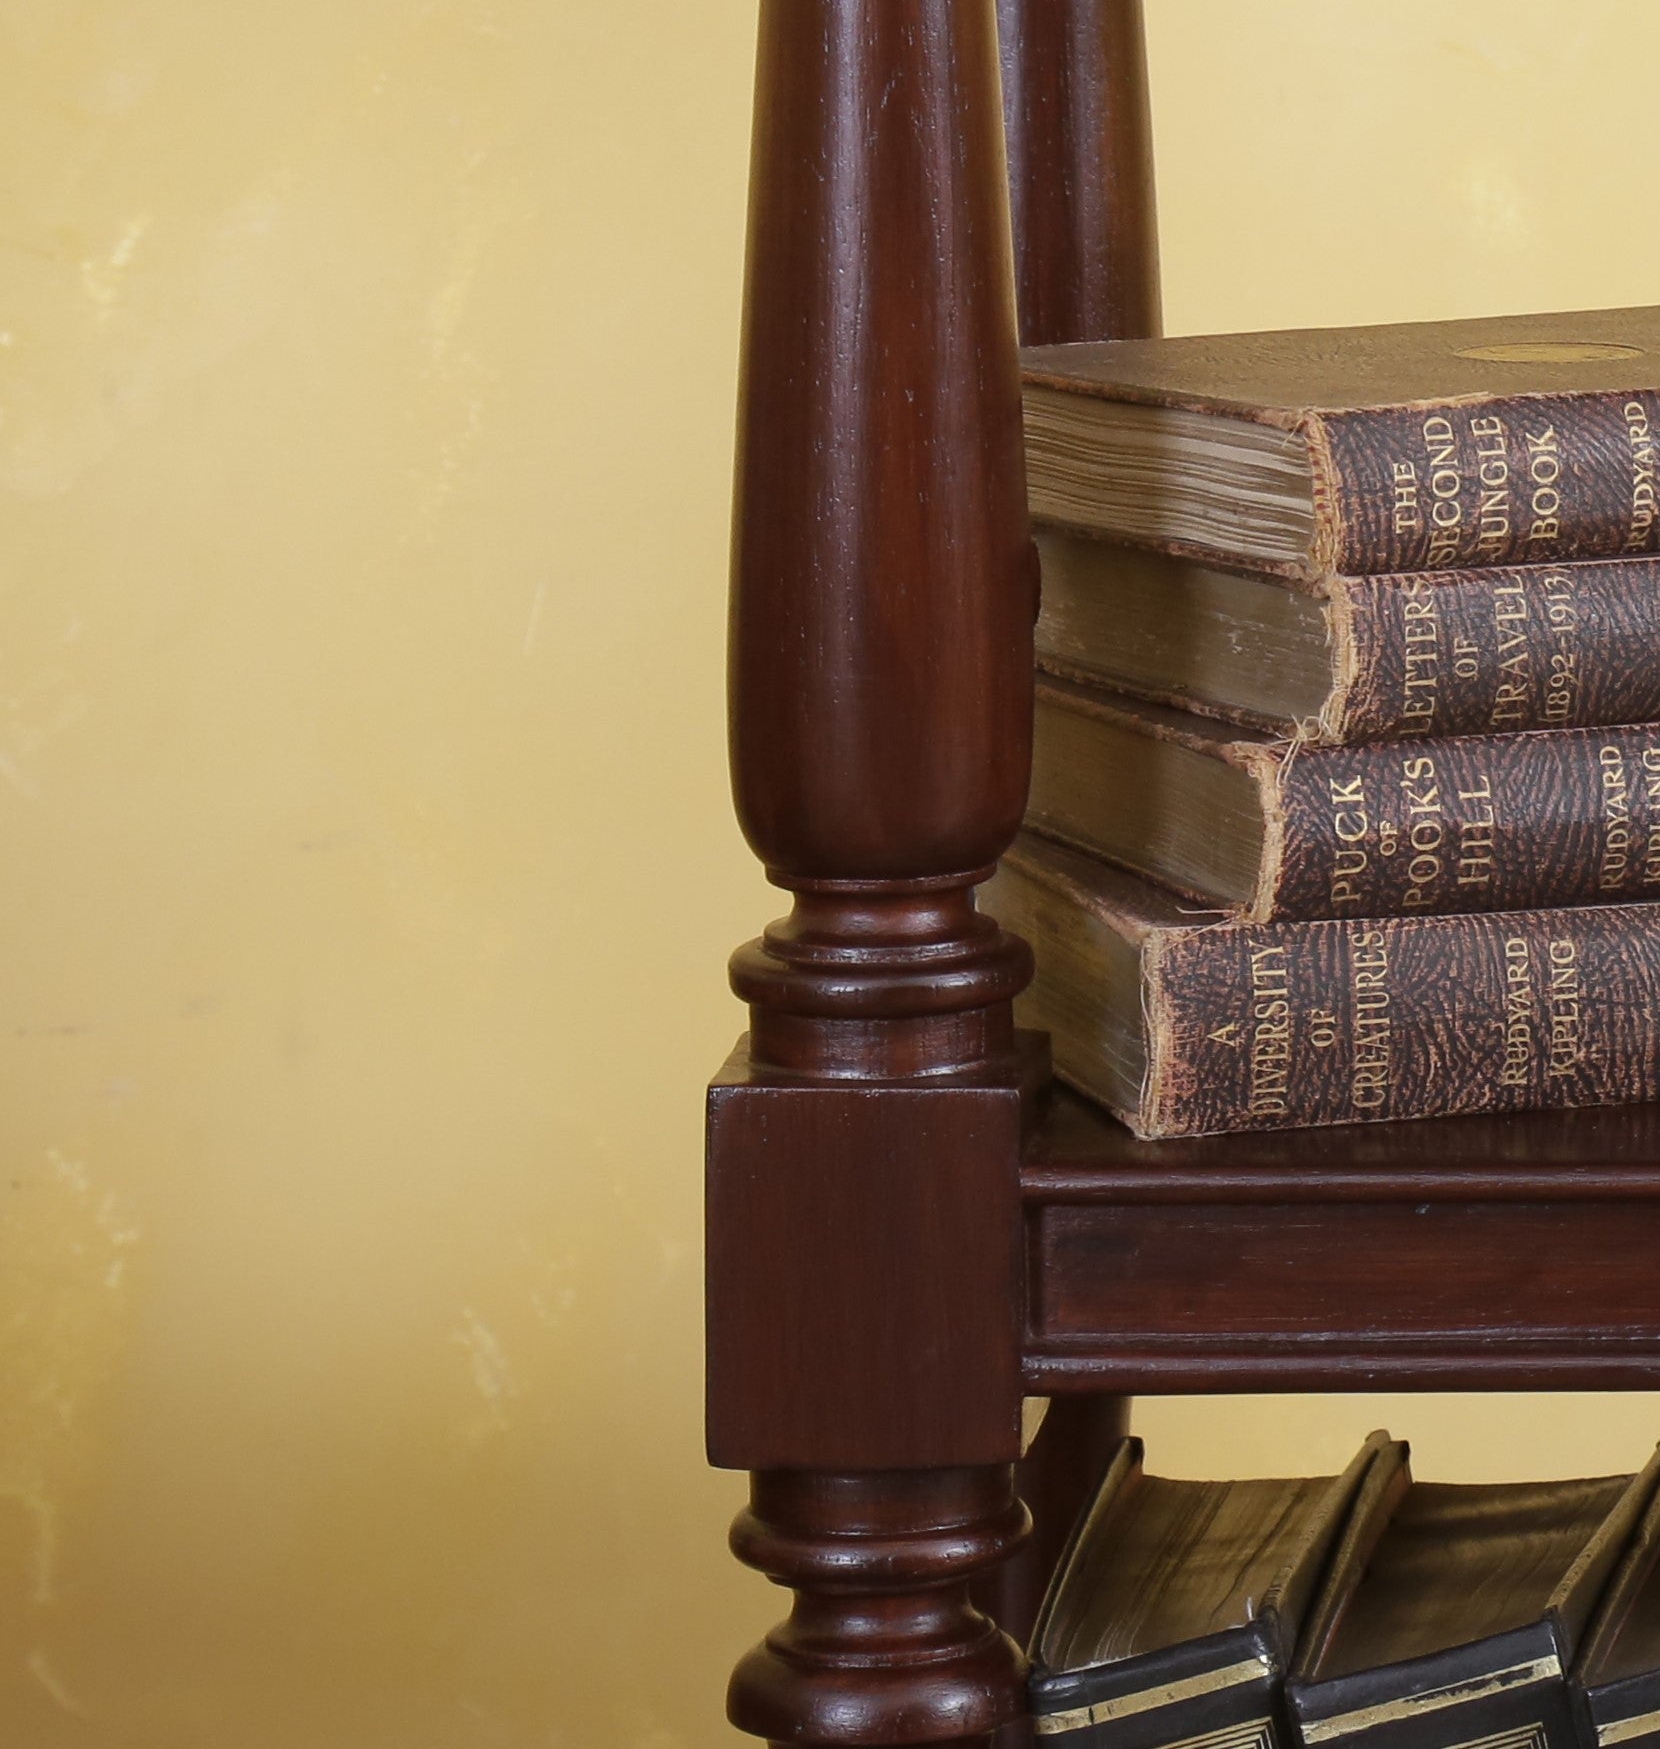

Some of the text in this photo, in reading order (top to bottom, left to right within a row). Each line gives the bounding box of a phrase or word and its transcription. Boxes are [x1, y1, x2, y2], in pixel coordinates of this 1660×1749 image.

[1393, 460, 1418, 534] THE
[1423, 415, 1461, 566] SECOND
[1470, 415, 1510, 558] JUNGLE
[1525, 425, 1560, 541] BOOK
[1624, 401, 1655, 550] RUDYARD
[1400, 577, 1439, 736] LETTERS
[1453, 638, 1480, 682] OF
[1489, 573, 1528, 726] TRAVEL
[1330, 774, 1369, 904] PUCK
[1380, 820, 1398, 856] OF
[1401, 756, 1443, 907] POOK'S
[1456, 774, 1495, 886] HILL
[1600, 745, 1630, 891] RUDYARD
[1207, 1023, 1237, 1047] A
[1250, 939, 1292, 1118] DIVERSITY
[1310, 1007, 1337, 1049] OF
[1350, 930, 1387, 1109] CREATURES
[1503, 936, 1529, 1086] RUDYARD
[1549, 938, 1578, 1078] KIPLING
